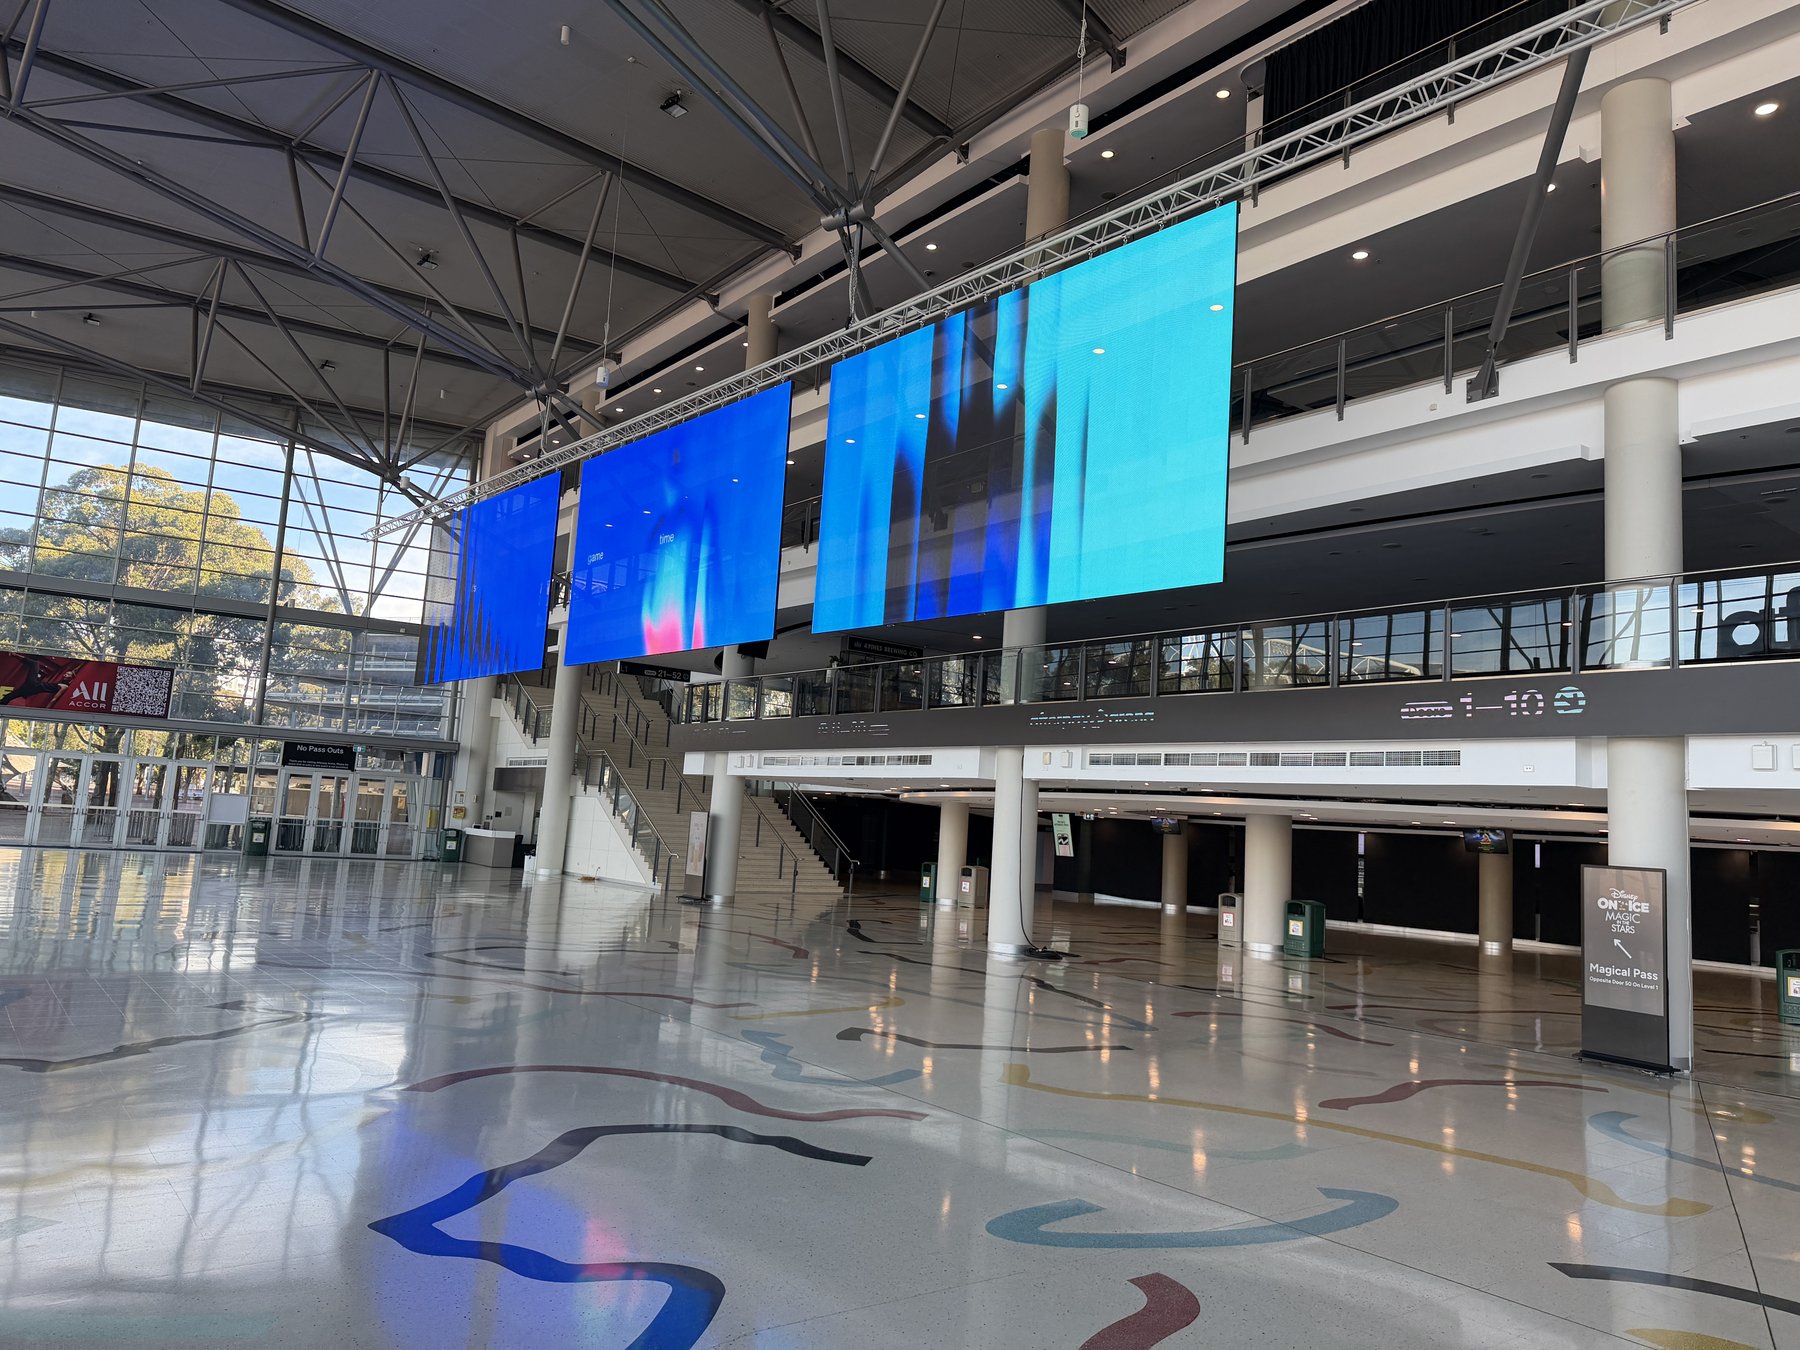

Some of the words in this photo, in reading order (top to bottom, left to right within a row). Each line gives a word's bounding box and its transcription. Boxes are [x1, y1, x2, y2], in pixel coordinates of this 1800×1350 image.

[587, 552, 604, 566] game
[659, 533, 675, 545] time
[68, 701, 107, 710] ACCOR
[296, 744, 308, 752] No
[308, 745, 326, 753] Pass
[1609, 888, 1639, 902] Disney
[1597, 897, 1617, 910] ON
[1628, 900, 1650, 913] ICE
[1605, 911, 1641, 924] MAGIC
[1611, 924, 1636, 934] STARS
[1589, 963, 1631, 977] Magical
[1633, 969, 1659, 981] Pass
[1589, 976, 1611, 984] Opposite
[1611, 979, 1624, 987] Door
